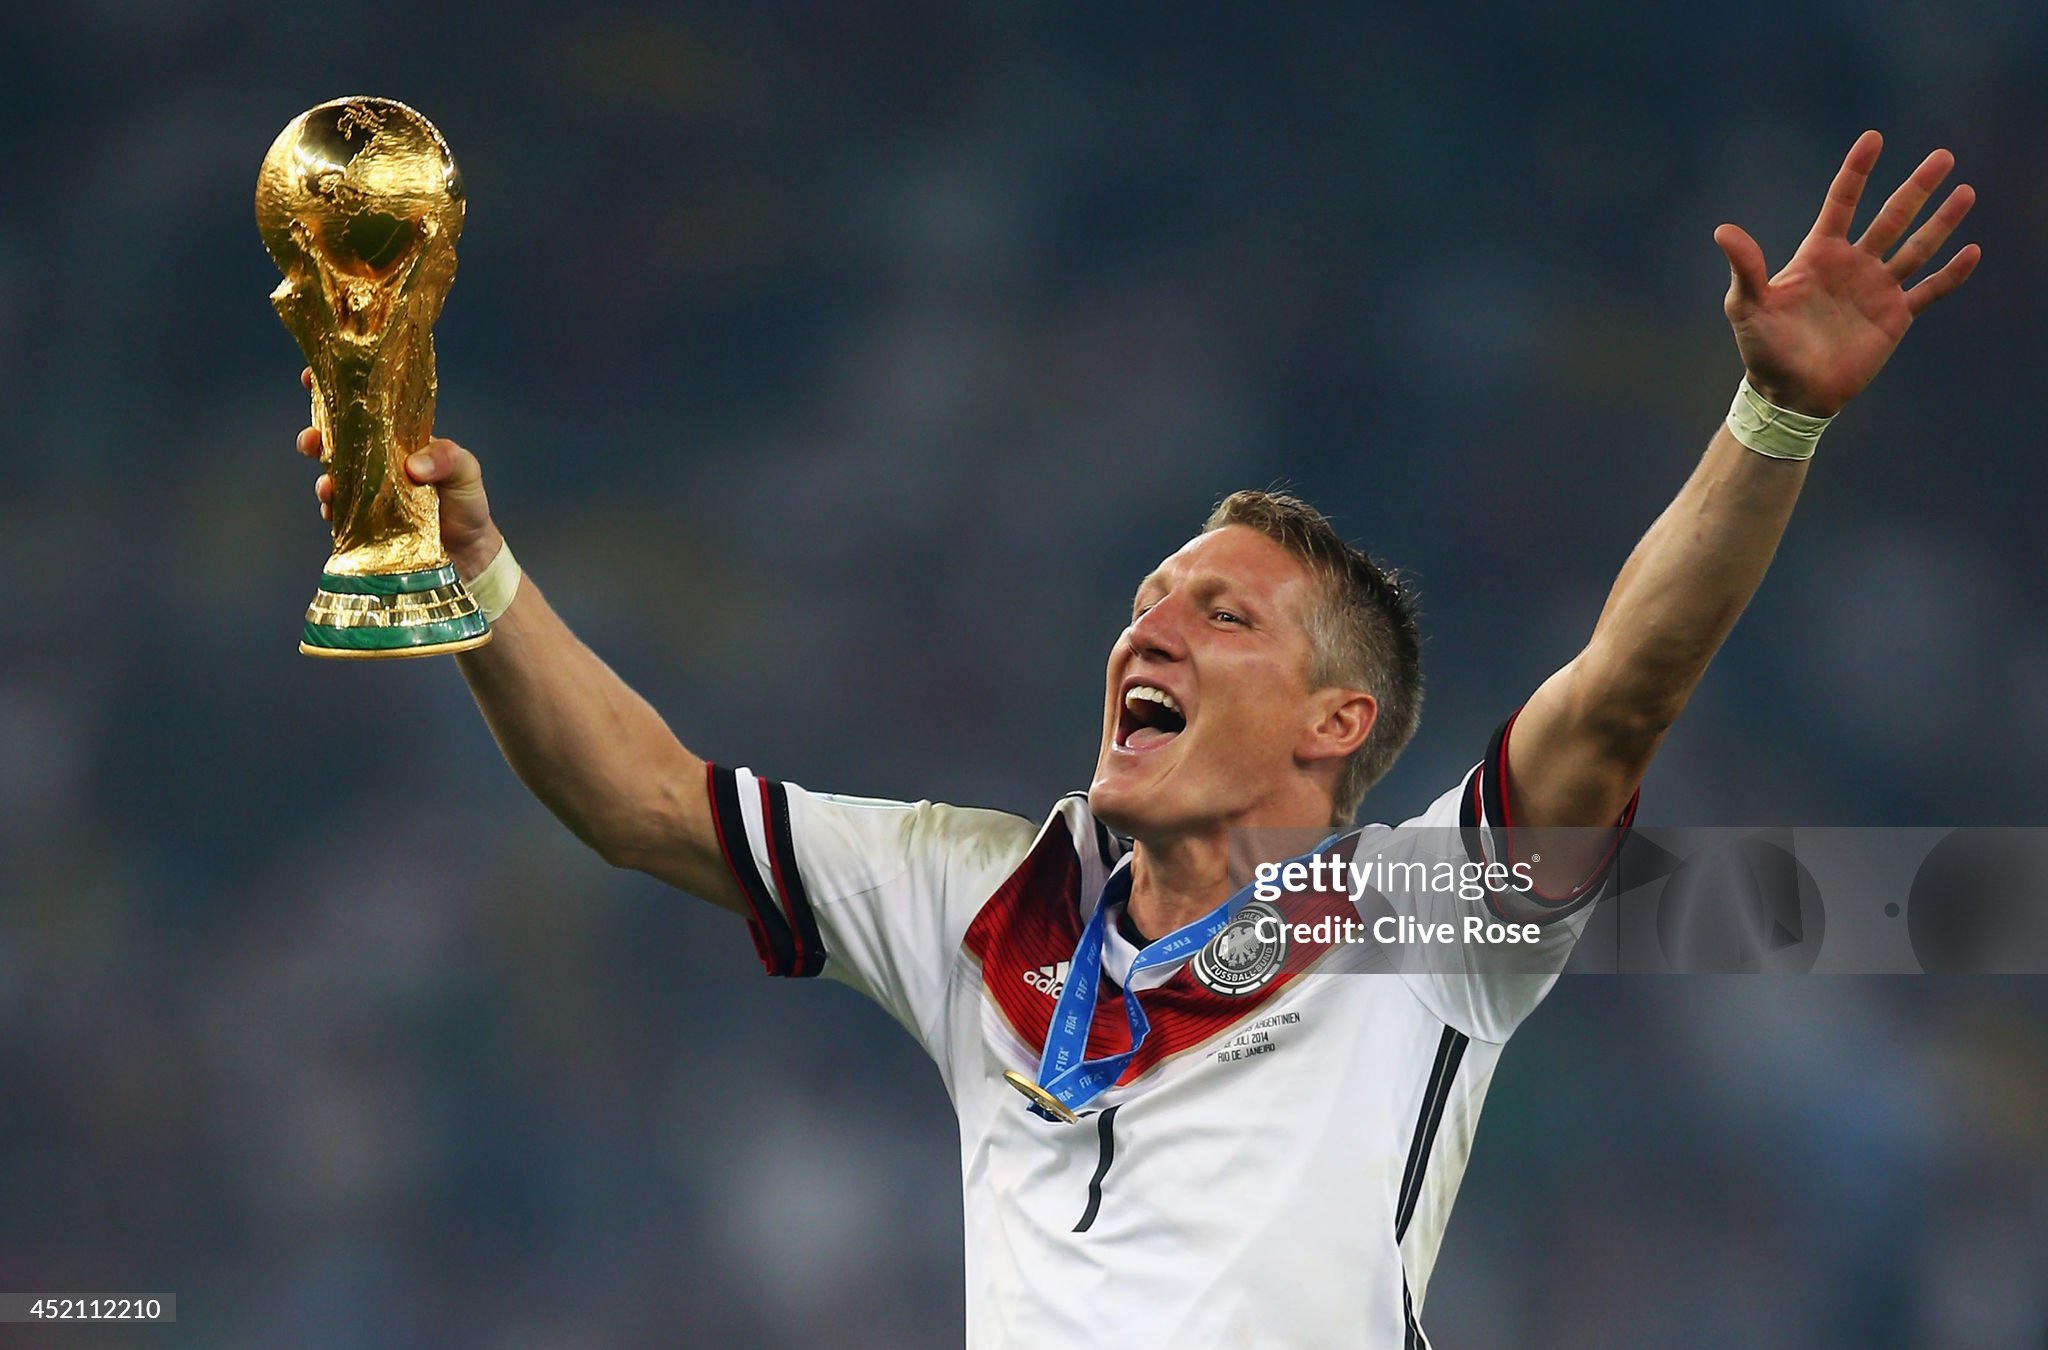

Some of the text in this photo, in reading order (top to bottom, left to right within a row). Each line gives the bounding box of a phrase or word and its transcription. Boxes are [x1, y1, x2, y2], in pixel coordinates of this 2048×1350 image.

[1210, 946, 1273, 982] FUSSBALL-BUND
[1251, 1031, 1269, 1044] 2014
[1217, 1051, 1231, 1064] RIO
[1231, 1049, 1243, 1061] DE
[1244, 1042, 1277, 1058] JANEIRO
